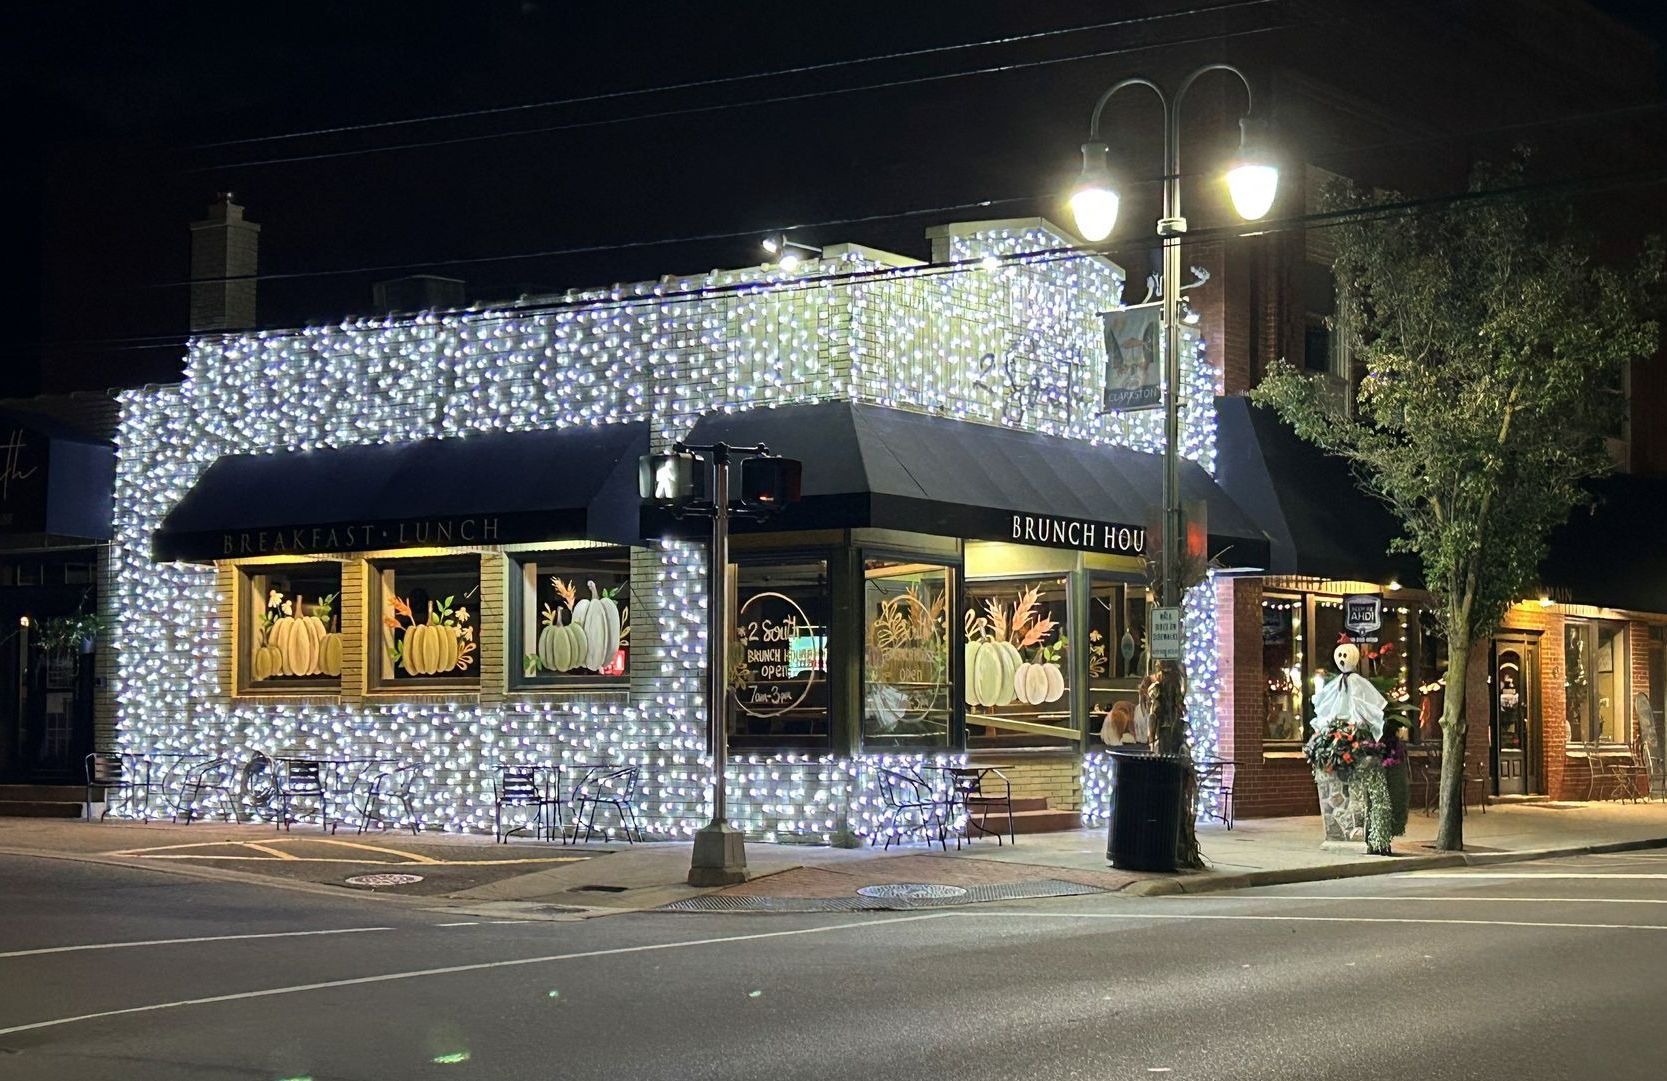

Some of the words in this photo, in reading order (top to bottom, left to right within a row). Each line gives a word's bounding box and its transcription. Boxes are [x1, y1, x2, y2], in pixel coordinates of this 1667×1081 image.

[223, 524, 375, 554] BREAKFAST
[399, 517, 499, 545] LUNCH
[1012, 515, 1095, 547] BRUNCH
[1104, 526, 1145, 552] HOU
[748, 622, 760, 641] 2
[762, 613, 801, 642] South
[747, 648, 781, 663] BRUNCH
[761, 664, 789, 679] open
